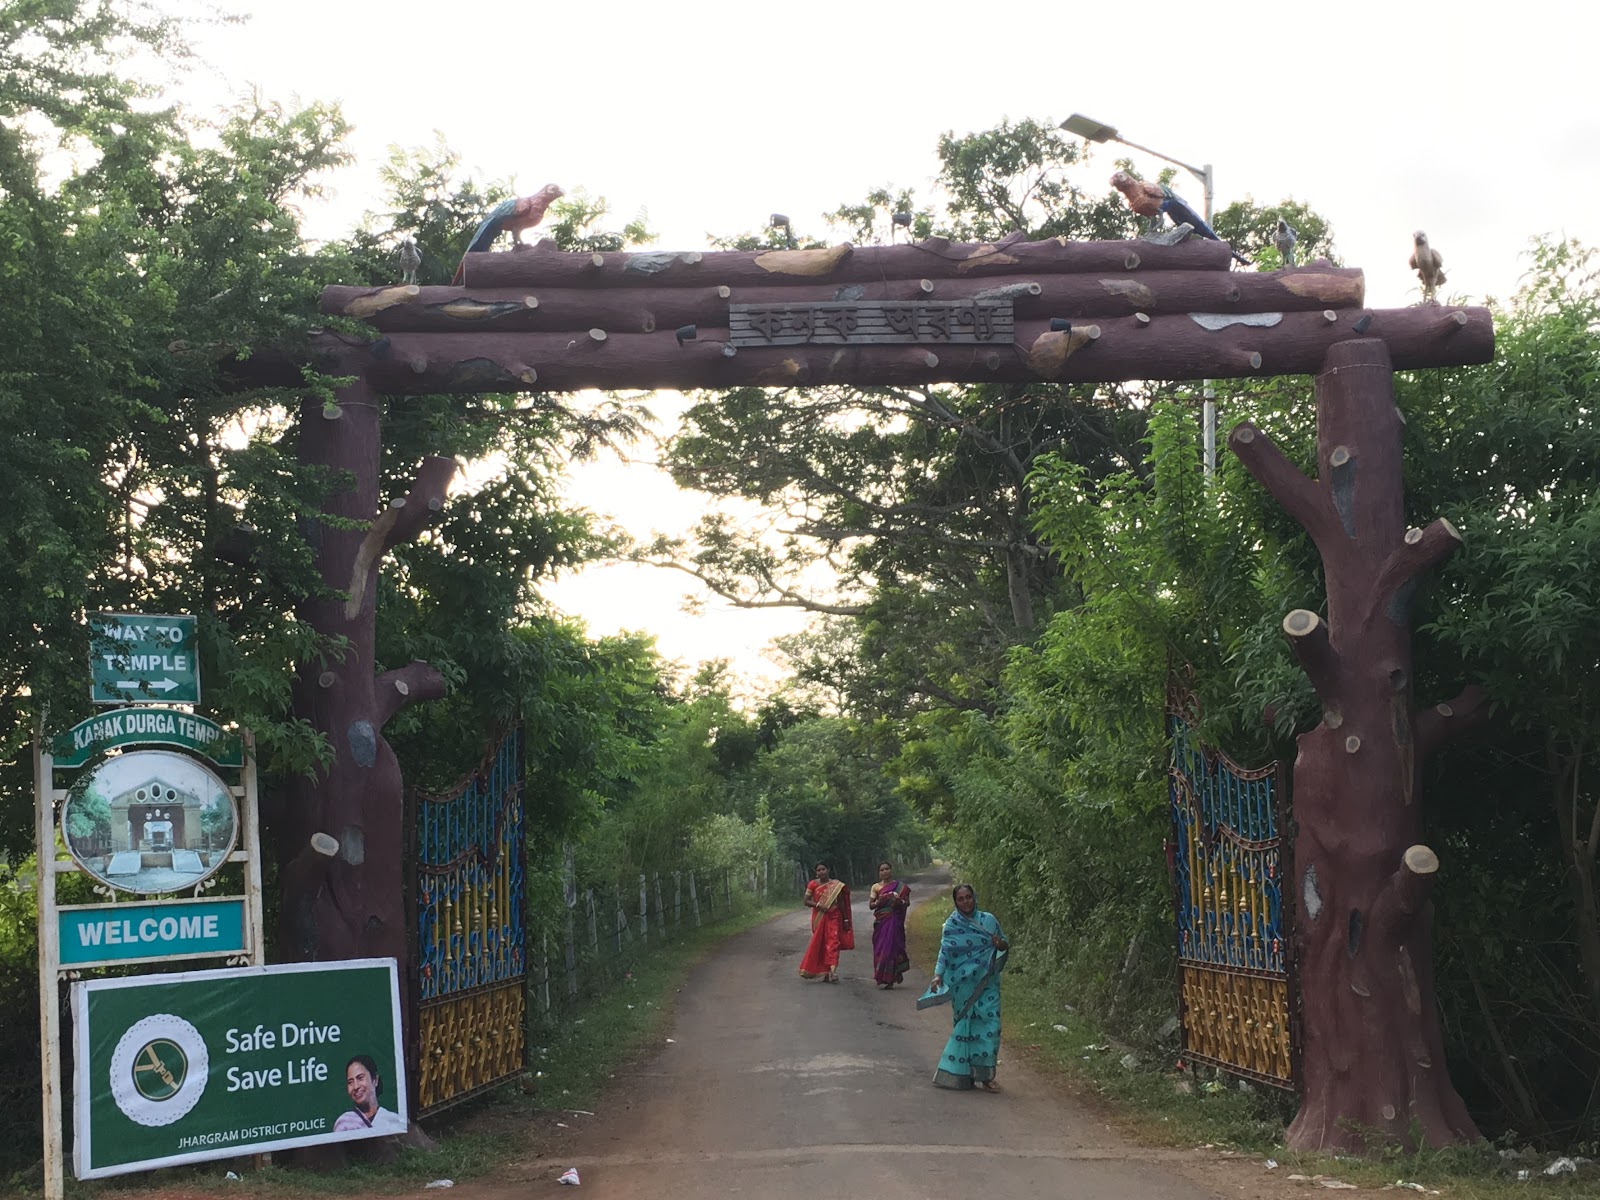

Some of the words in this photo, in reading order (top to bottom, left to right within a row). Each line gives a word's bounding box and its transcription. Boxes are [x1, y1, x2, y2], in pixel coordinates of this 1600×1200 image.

[102, 654, 187, 671] TEMPLE
[73, 715, 124, 750] KANAK
[126, 714, 176, 734] DURGA
[178, 716, 223, 746] TEMP
[77, 915, 219, 947] WELCOME
[225, 1024, 276, 1054] Safe
[281, 1020, 341, 1048] Drive
[226, 1066, 282, 1092] Save
[287, 1056, 328, 1085] Life
[177, 1129, 239, 1149] JHARGRAM
[241, 1122, 288, 1140] DISTRICT
[290, 1117, 326, 1133] POLICE
